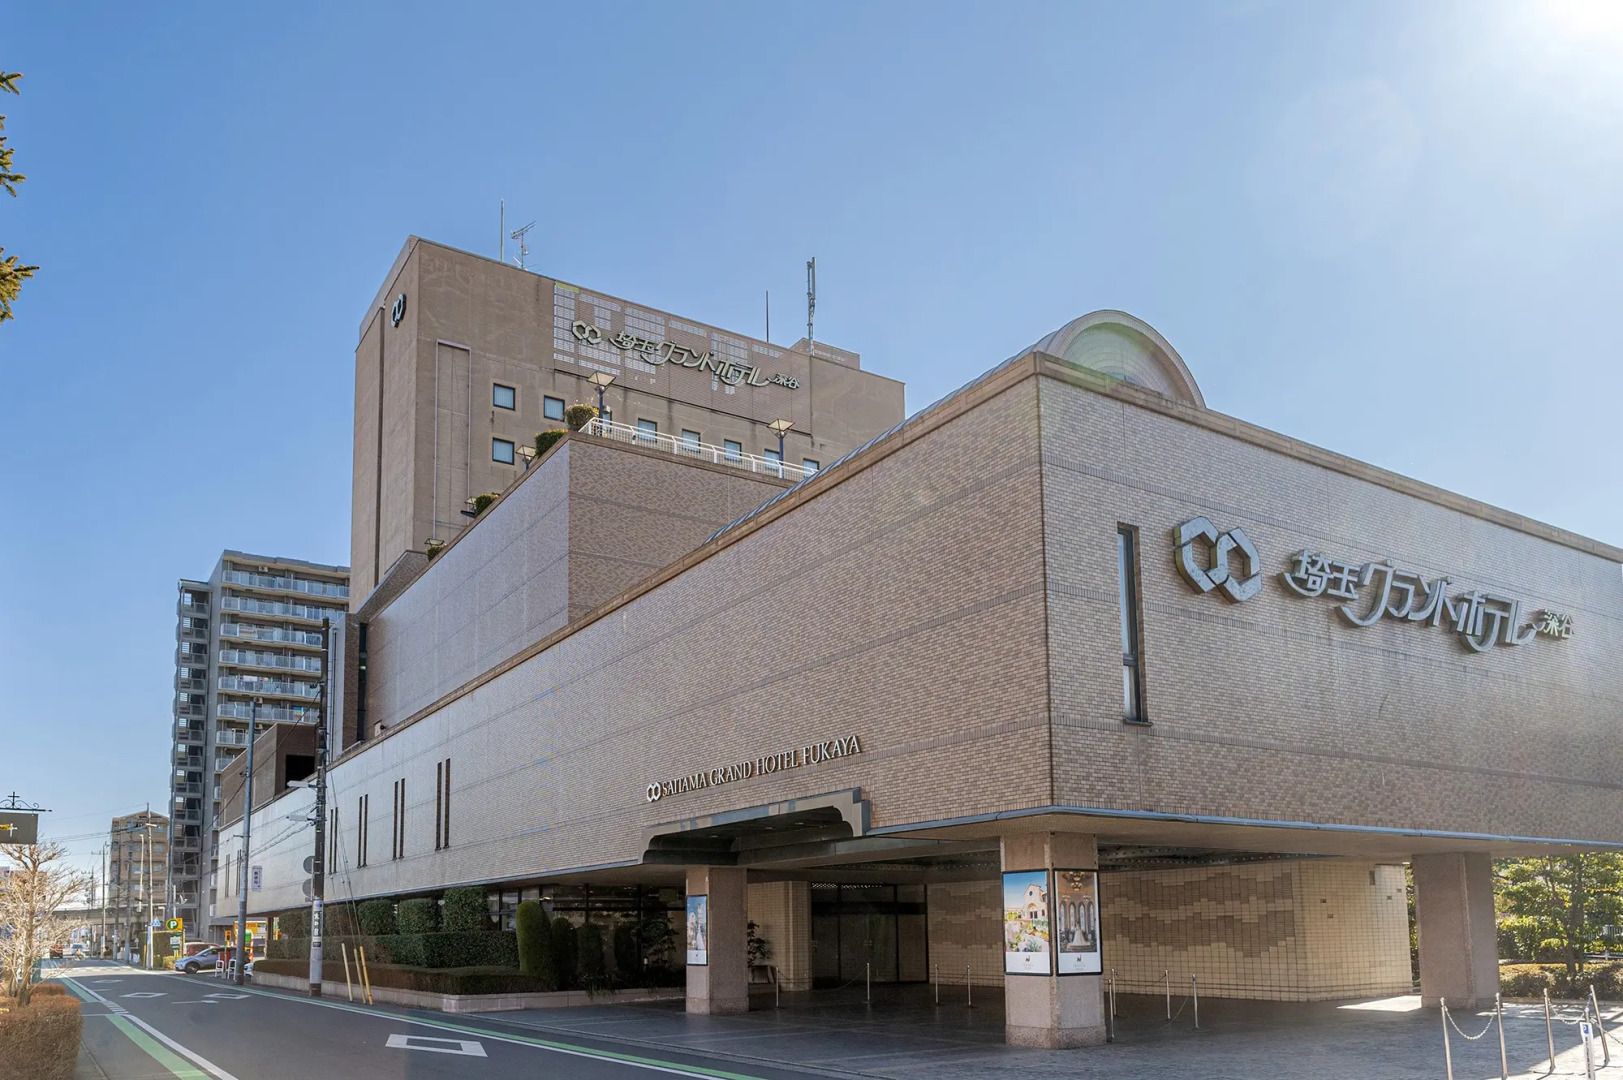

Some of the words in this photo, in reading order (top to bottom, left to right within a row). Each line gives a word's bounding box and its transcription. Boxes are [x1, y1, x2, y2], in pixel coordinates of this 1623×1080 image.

[662, 772, 708, 797] SAITAMA
[709, 760, 752, 786] GRAND
[756, 749, 800, 776] HOTEL
[803, 735, 861, 765] FUKAYA
[170, 920, 178, 929] P
